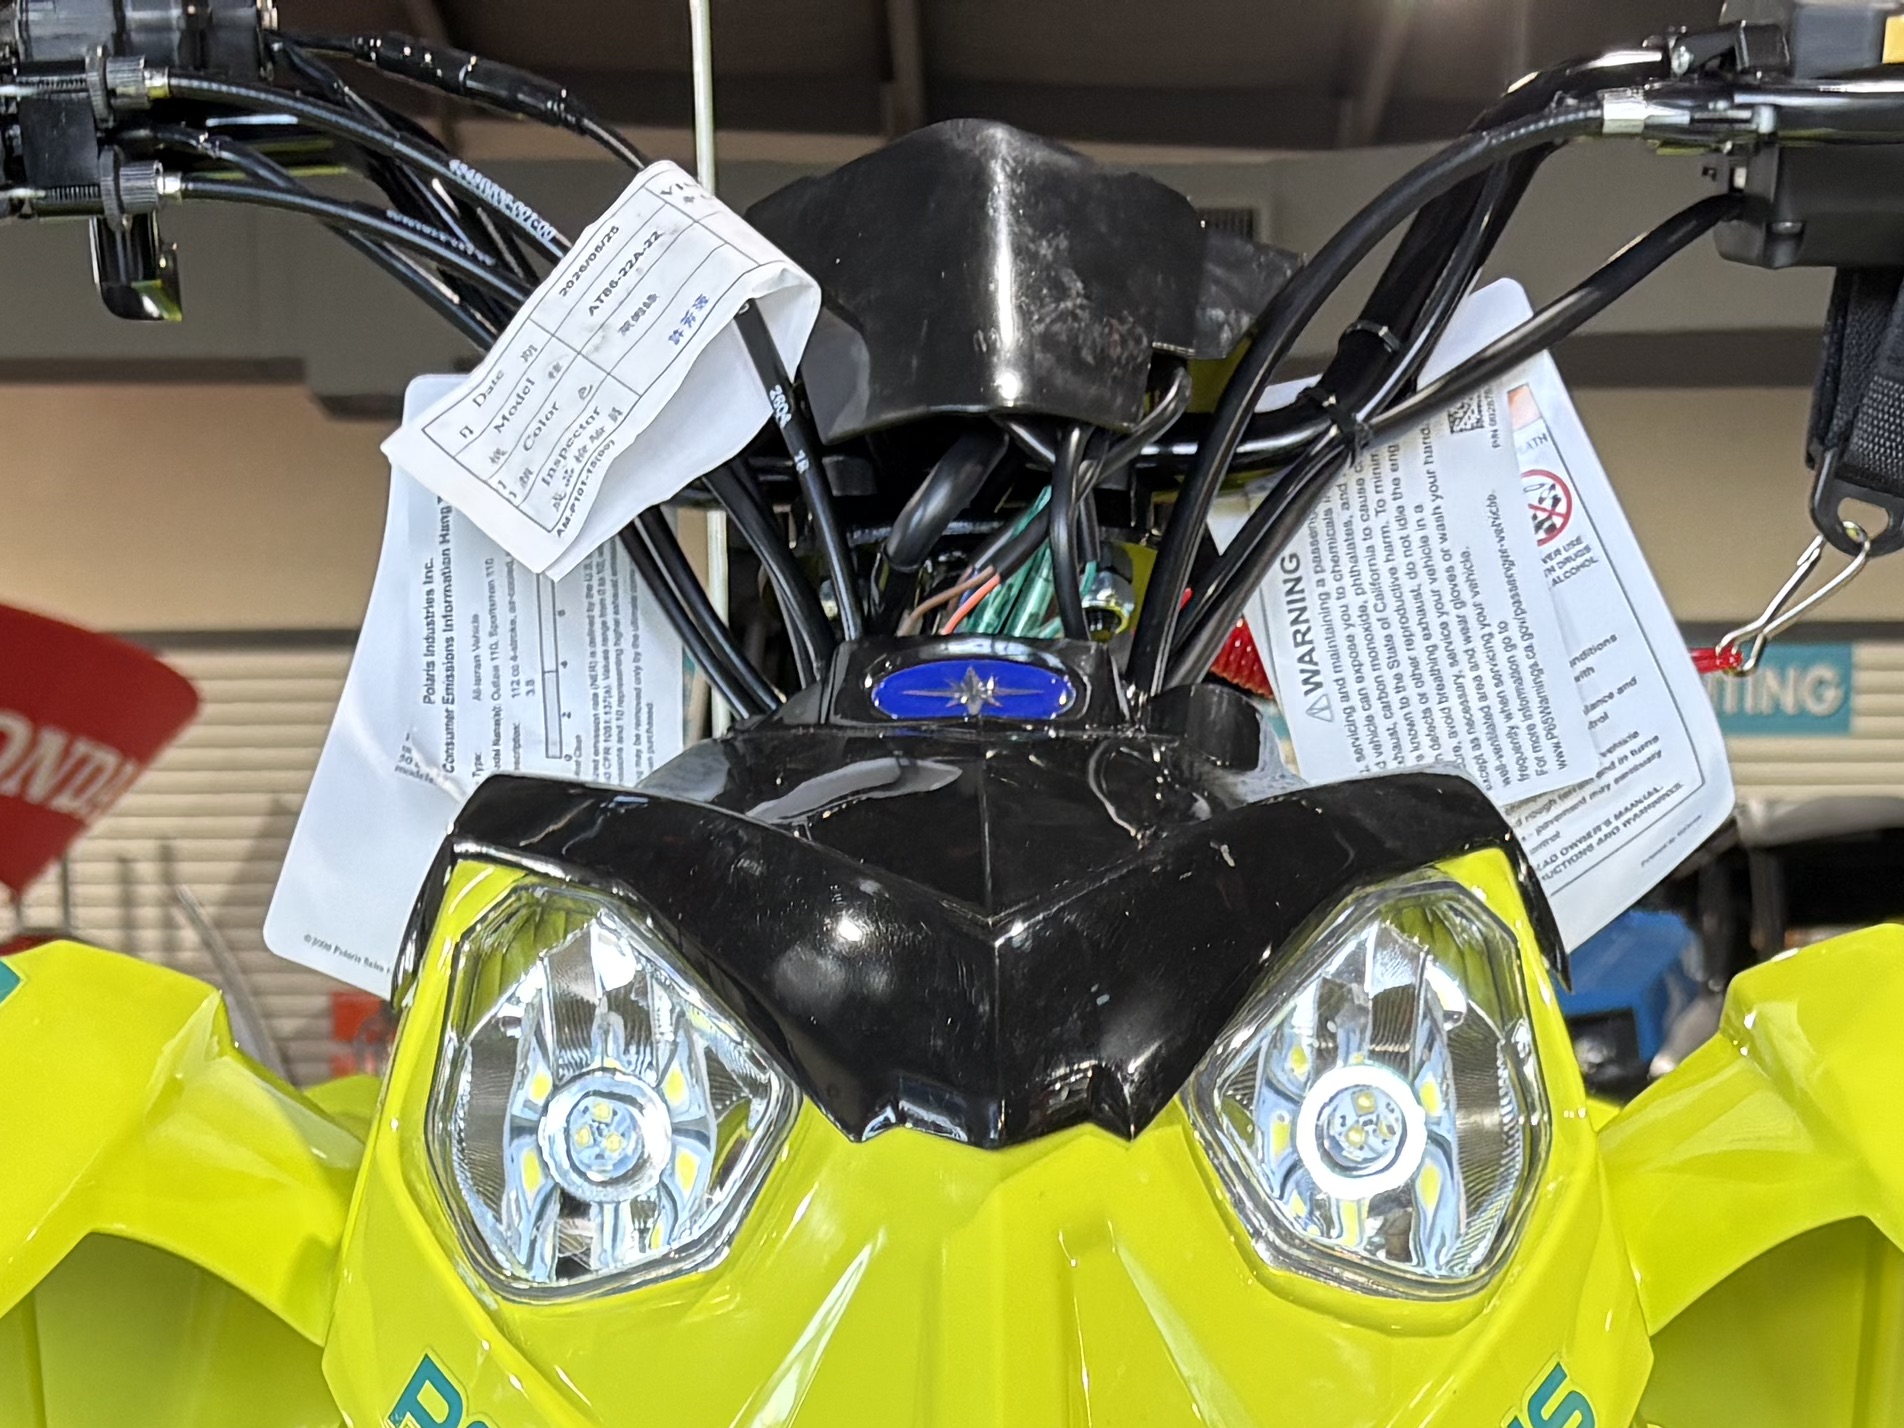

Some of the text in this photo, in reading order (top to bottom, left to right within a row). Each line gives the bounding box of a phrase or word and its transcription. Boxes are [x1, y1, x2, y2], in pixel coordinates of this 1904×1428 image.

[472, 371, 504, 407] Date
[493, 378, 535, 433] Model
[523, 402, 559, 451] Color
[542, 406, 600, 486] Inspector
[1414, 504, 1424, 513] a
[1416, 518, 1426, 531] in
[485, 558, 494, 577] 110
[1420, 535, 1436, 576] vehicle
[1548, 557, 1599, 587] ALCOHOL
[440, 548, 453, 632] Information
[586, 601, 595, 612] by
[1335, 482, 1393, 719] carbon monoxide, phthalates, and
[1391, 477, 1457, 739] avoid breathing exhaust, do not idle the
[1430, 590, 1447, 618] your
[423, 558, 435, 704] Polaris Industries Inc.
[472, 614, 480, 652] Vehicle
[1276, 552, 1323, 696] WARNING
[1317, 507, 1383, 758] vehicle can expose you to chemicals
[1356, 477, 1420, 752] known to the State of California to cause
[1374, 499, 1441, 751] defects or other reproductive harm. To
[1426, 469, 1511, 787] well-ventilated area and wear gloves or wash your
[633, 651, 641, 663] by
[1439, 621, 1459, 667] service
[1460, 546, 1530, 782] frequently when servicing your vehicle.
[442, 636, 455, 705] Emissions
[511, 679, 520, 698] 112
[633, 665, 643, 685] only
[1316, 578, 1366, 762] servicing and maintaining a
[1617, 676, 1637, 695] and
[634, 687, 642, 731] removed
[1452, 670, 1476, 735] necessary,
[1497, 621, 1548, 776] For more information go to
[442, 708, 455, 773] Consumer
[1470, 737, 1481, 751] as
[1589, 783, 1610, 800] may
[1597, 826, 1620, 846] AND
